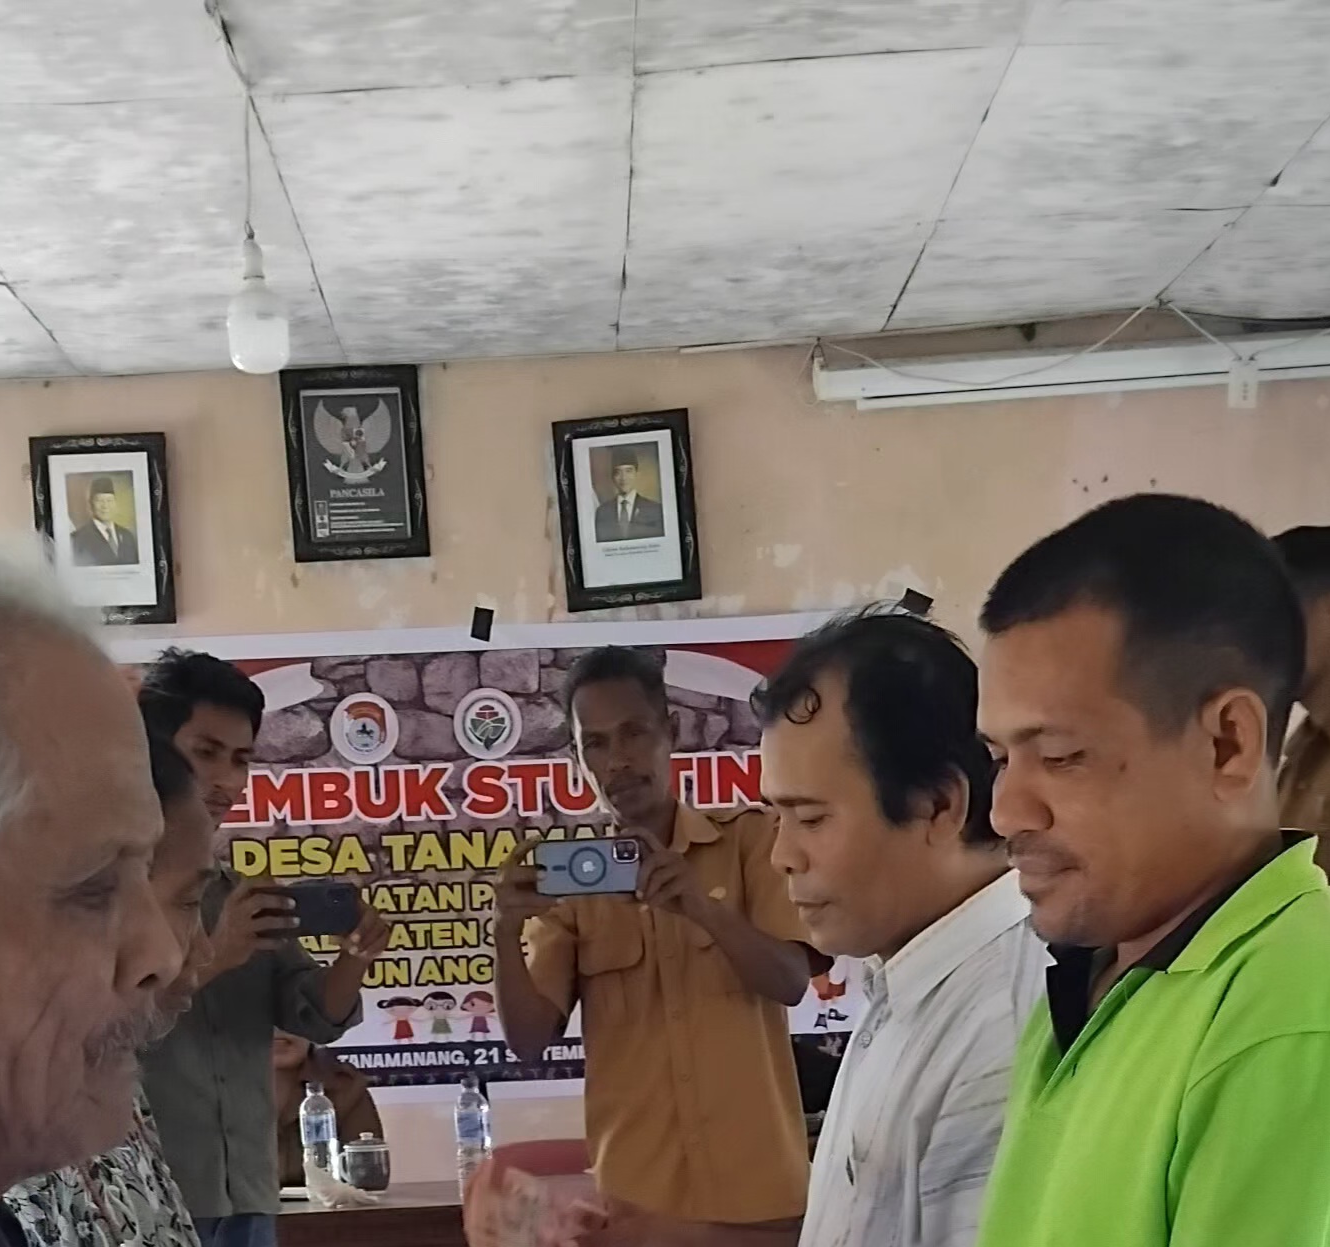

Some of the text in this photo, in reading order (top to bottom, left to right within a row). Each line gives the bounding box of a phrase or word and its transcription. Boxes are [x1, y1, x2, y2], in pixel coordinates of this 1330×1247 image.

[330, 487, 386, 498] PANCASILA
[231, 833, 373, 877] DESA
[362, 883, 465, 913] ATAN
[337, 1049, 470, 1069] TANAMANANG,
[474, 1048, 498, 1065] 21
